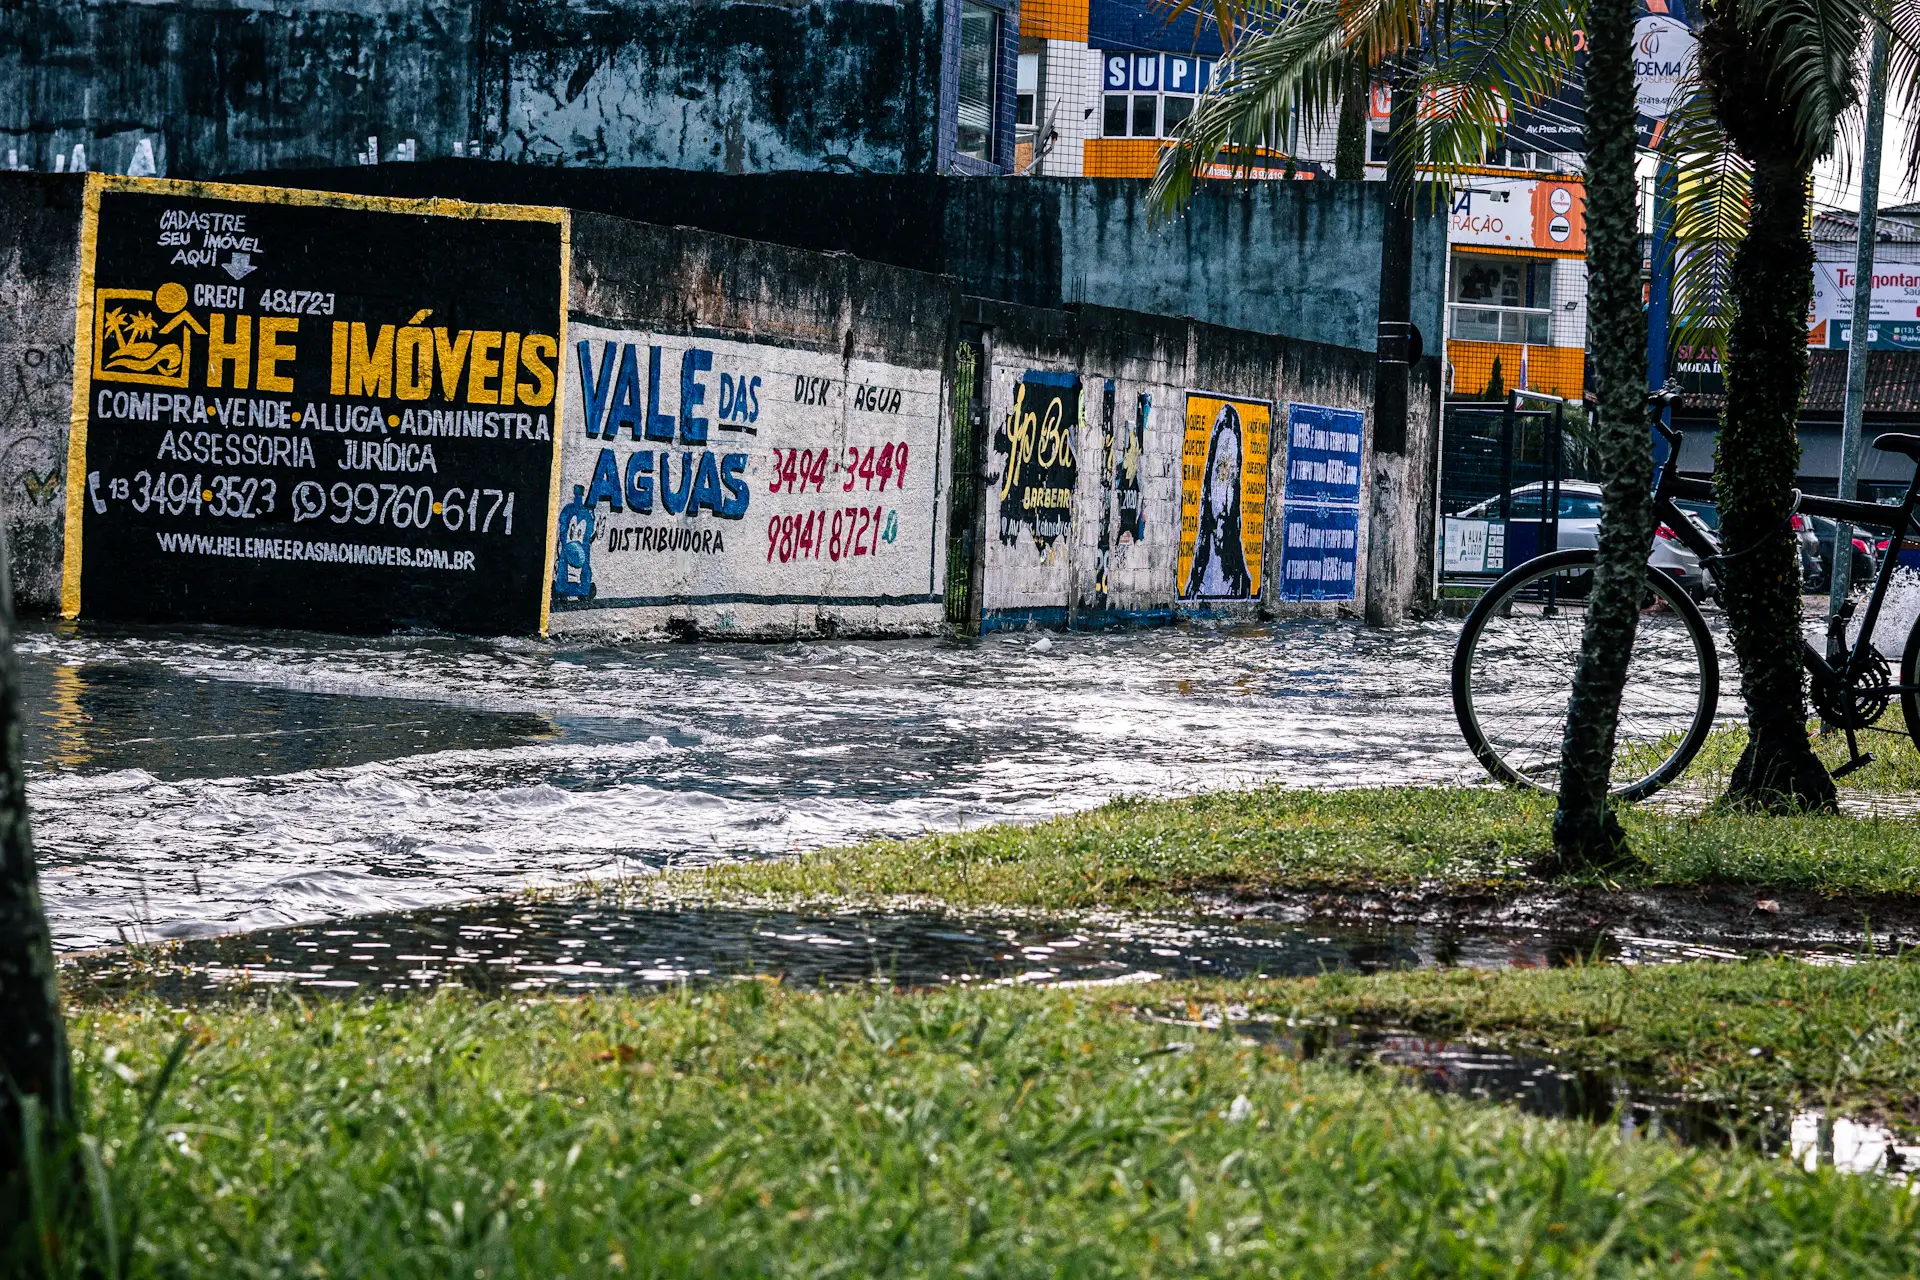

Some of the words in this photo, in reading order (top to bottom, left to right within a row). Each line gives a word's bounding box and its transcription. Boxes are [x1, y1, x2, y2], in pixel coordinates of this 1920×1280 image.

[160, 209, 246, 232] CADASTRE
[157, 231, 191, 246] SEU
[203, 230, 264, 253] IMÓVEL
[170, 247, 217, 268] AQUI
[194, 283, 245, 310] CRECI
[207, 312, 299, 393] HE
[330, 308, 558, 408] IMÓVEIS
[1677, 362, 1711, 373] MODA
[577, 339, 713, 446] VALE
[718, 372, 762, 424] DAS
[794, 374, 832, 407] DISK
[853, 377, 902, 414] ÁGUA
[97, 389, 207, 425] COMPRA
[214, 397, 293, 429] VENDE
[300, 401, 388, 434] ALUGA
[400, 408, 551, 442] ADMINISTRA
[1293, 422, 1310, 448] DEUS
[1330, 431, 1346, 452] TEMPO
[157, 430, 317, 470] ASSESSORIA
[337, 437, 438, 474] JURÍDICA
[1297, 461, 1313, 481] TEMPO
[1327, 459, 1343, 484] DEUS
[608, 526, 725, 555] DISTRIBUIDORA
[766, 509, 826, 565] 98141
[829, 505, 882, 563] 8721
[1288, 522, 1305, 547] DEUS
[1325, 530, 1341, 549] TEMPO
[156, 532, 476, 571] WWW.HELENAEERASMOIMOVEIS.COM.BR
[1291, 560, 1308, 580] TEMPO
[1322, 557, 1338, 581] DEUS
